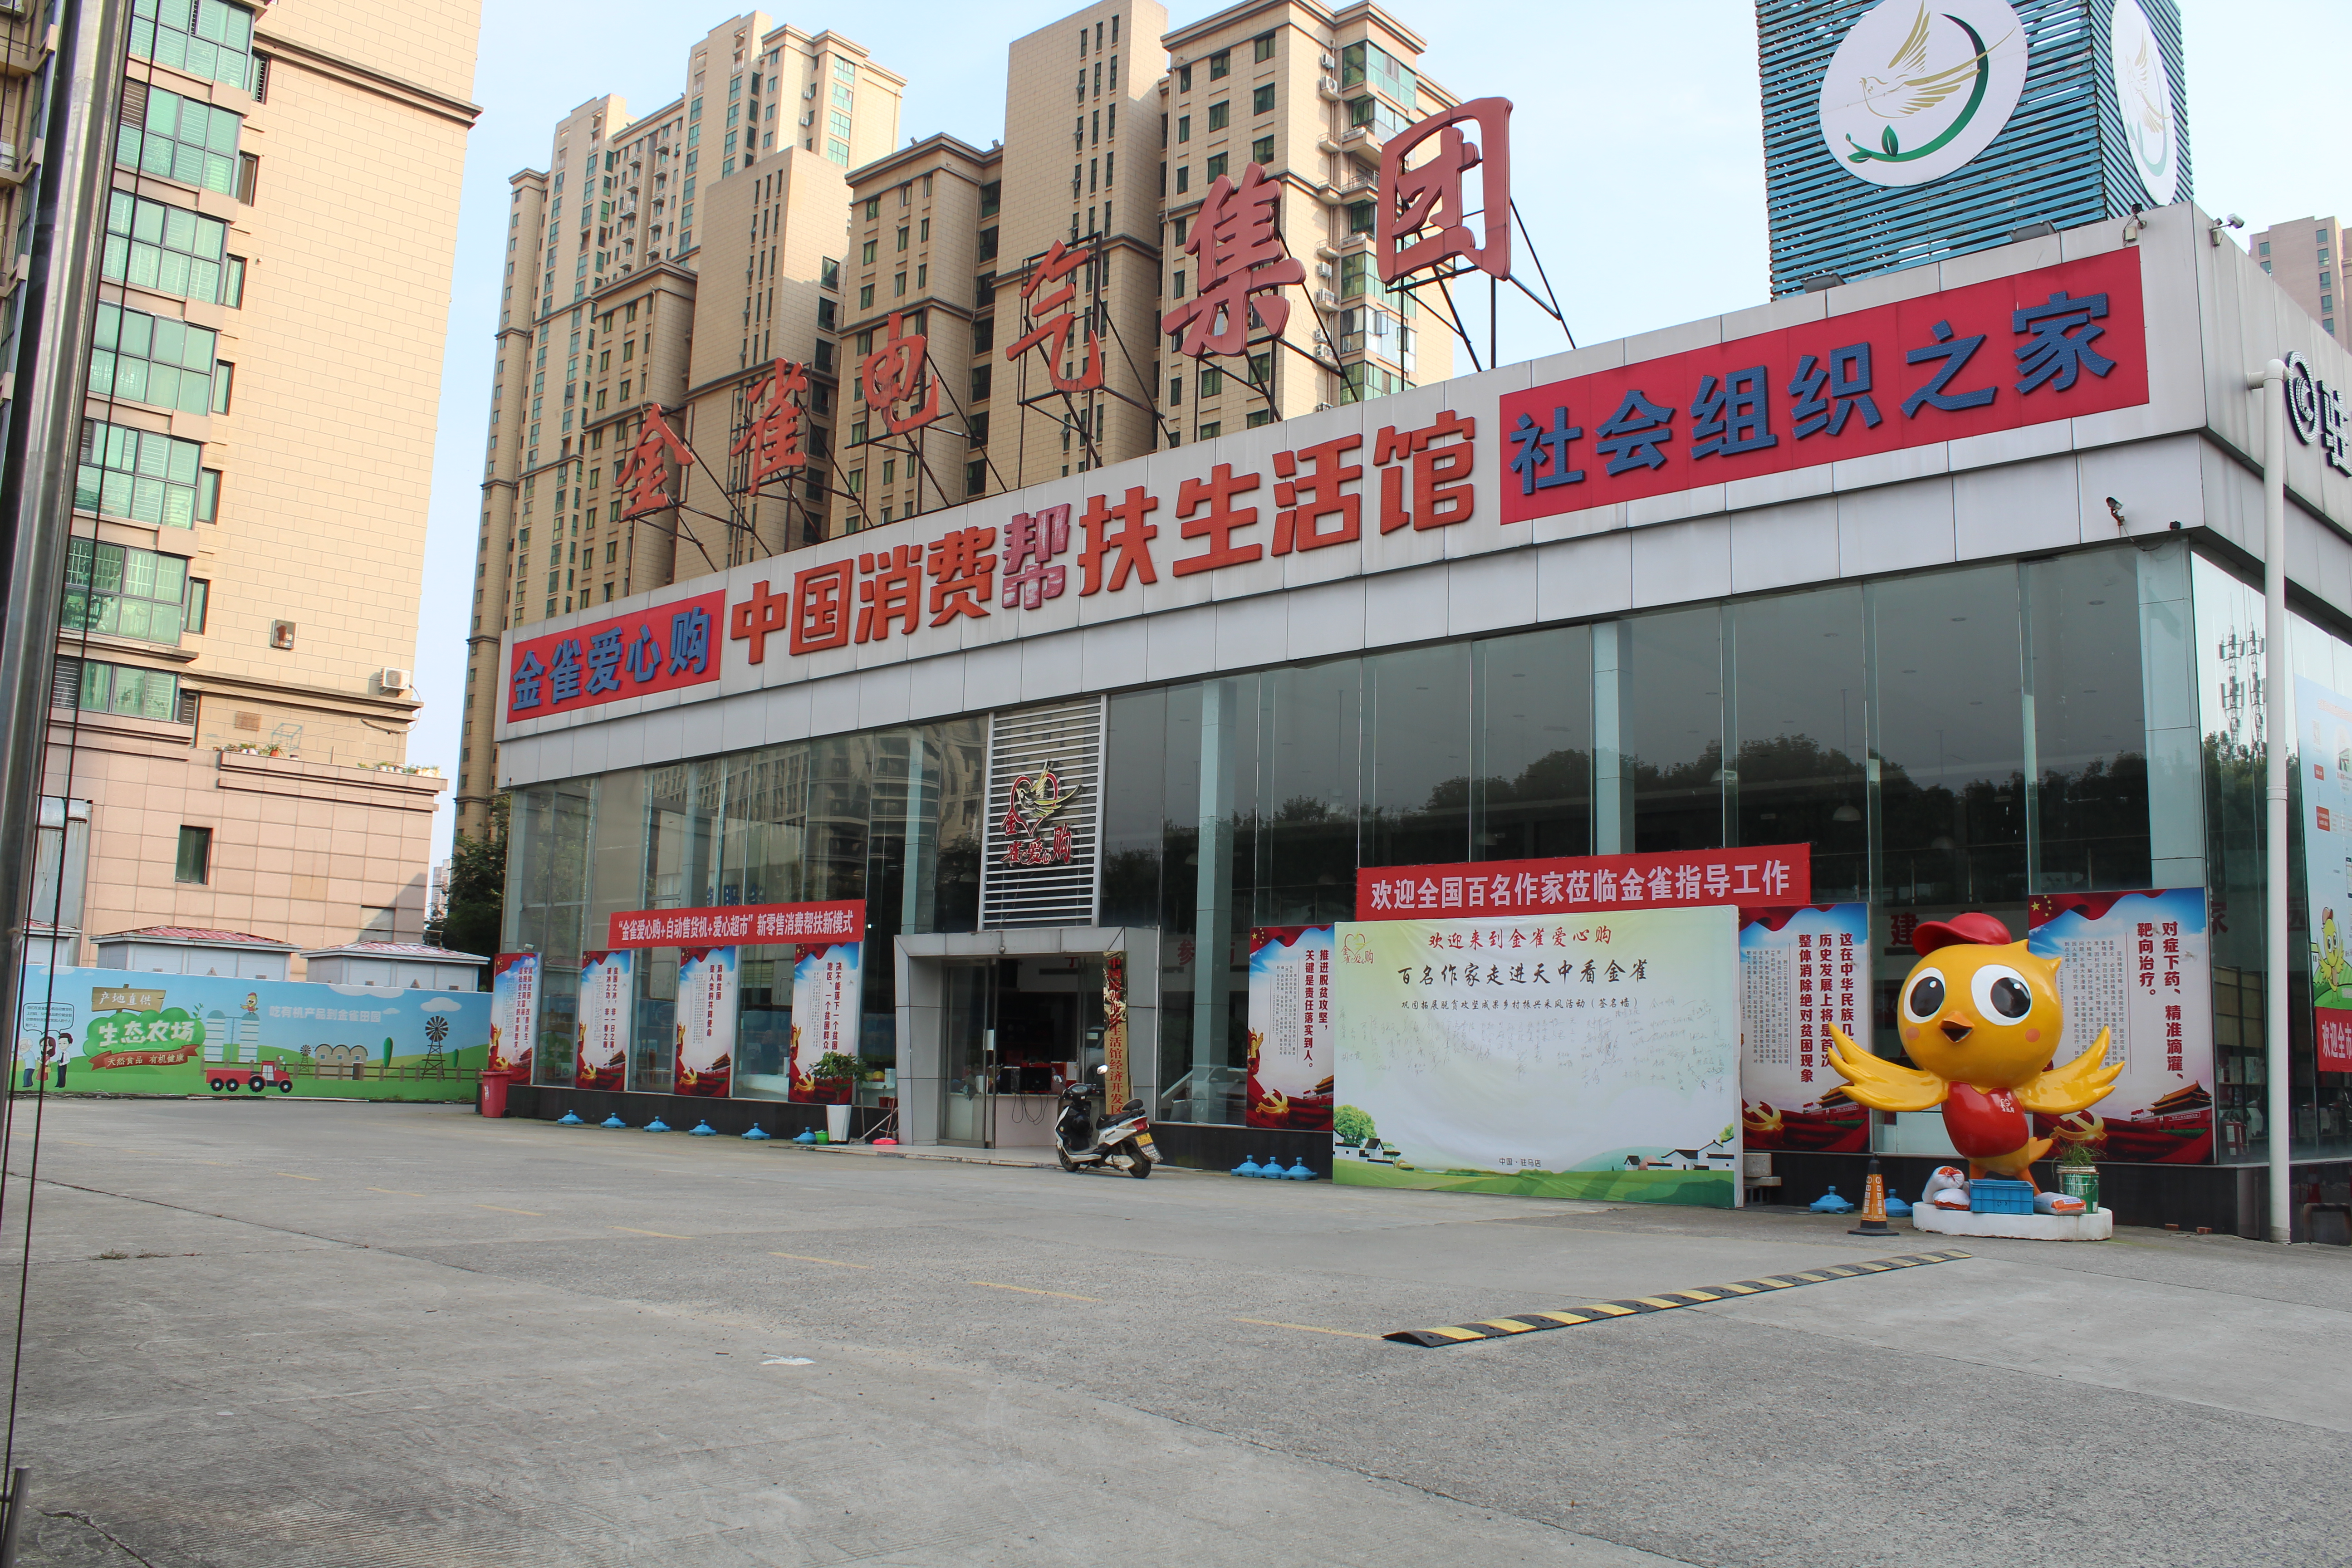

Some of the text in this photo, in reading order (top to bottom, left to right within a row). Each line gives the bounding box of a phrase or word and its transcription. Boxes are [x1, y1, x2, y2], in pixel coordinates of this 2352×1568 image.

[616, 97, 1513, 520] 金雀电气集团
[1509, 290, 2116, 495] 社会组织之家
[730, 409, 1475, 665] 中国消费帮扶生活馆
[512, 606, 710, 710] 金雀爱心购
[757, 910, 853, 936] 新零售消费帮扶新模式
[1371, 859, 1790, 910] 欢迎全国百名作家莅临金雀指导工作
[1397, 959, 1647, 987] 百名作家走进天中看金雀
[1428, 925, 1612, 951] 欢迎来到金雀爱心购
[2137, 922, 2156, 995] 靶向治疗。
[99, 991, 151, 1005] 产地直供
[269, 1005, 381, 1023] 吃有机产品到金雀田园
[706, 965, 715, 1037] 是人类的共同使命
[823, 962, 833, 1050] 地区、一个贫困群众
[832, 962, 842, 1050] 决不能落下一个贫困
[1303, 950, 1315, 1068] 关键是责任落实到人。
[1799, 935, 1813, 1083] 整体消除绝对贫困现象
[1819, 934, 1833, 1068] 历史发展上将是首次
[1840, 933, 1854, 1042] 这在中华民族几
[99, 1020, 195, 1047] 生态农场
[107, 1053, 185, 1067] 天然食品 有机健康
